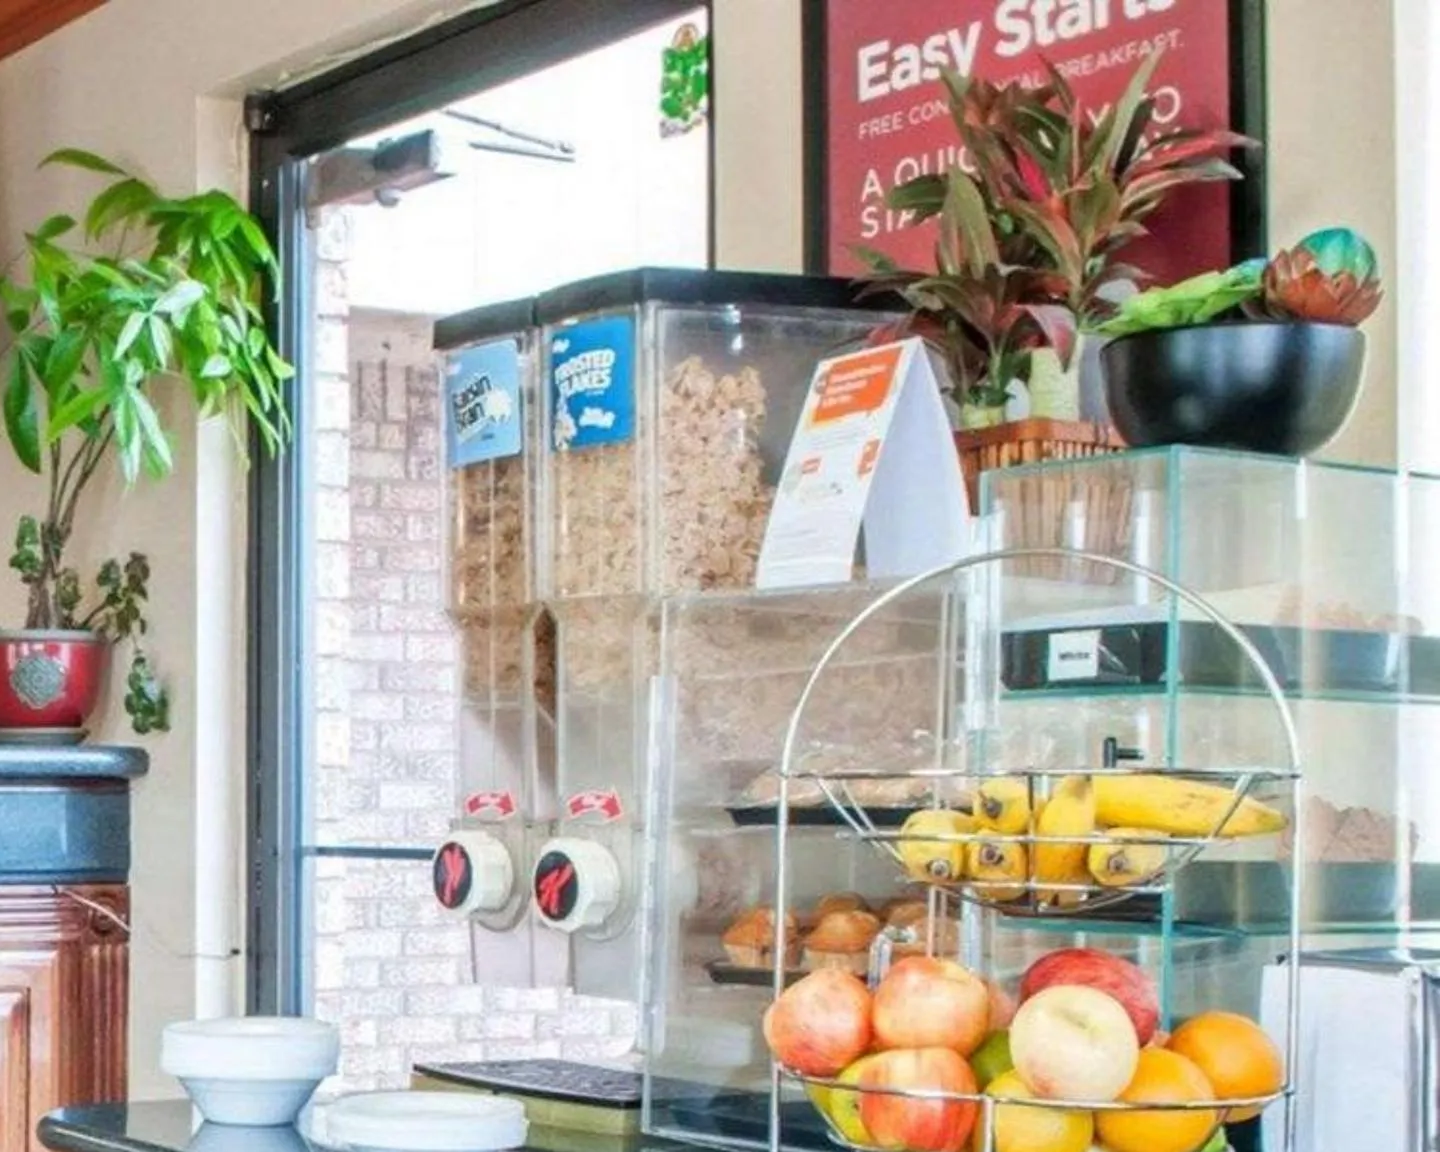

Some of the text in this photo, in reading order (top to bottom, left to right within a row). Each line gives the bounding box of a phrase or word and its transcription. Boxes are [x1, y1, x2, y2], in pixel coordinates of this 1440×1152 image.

[858, 21, 982, 103] Easy
[858, 110, 905, 140] FREE
[862, 168, 884, 202] A
